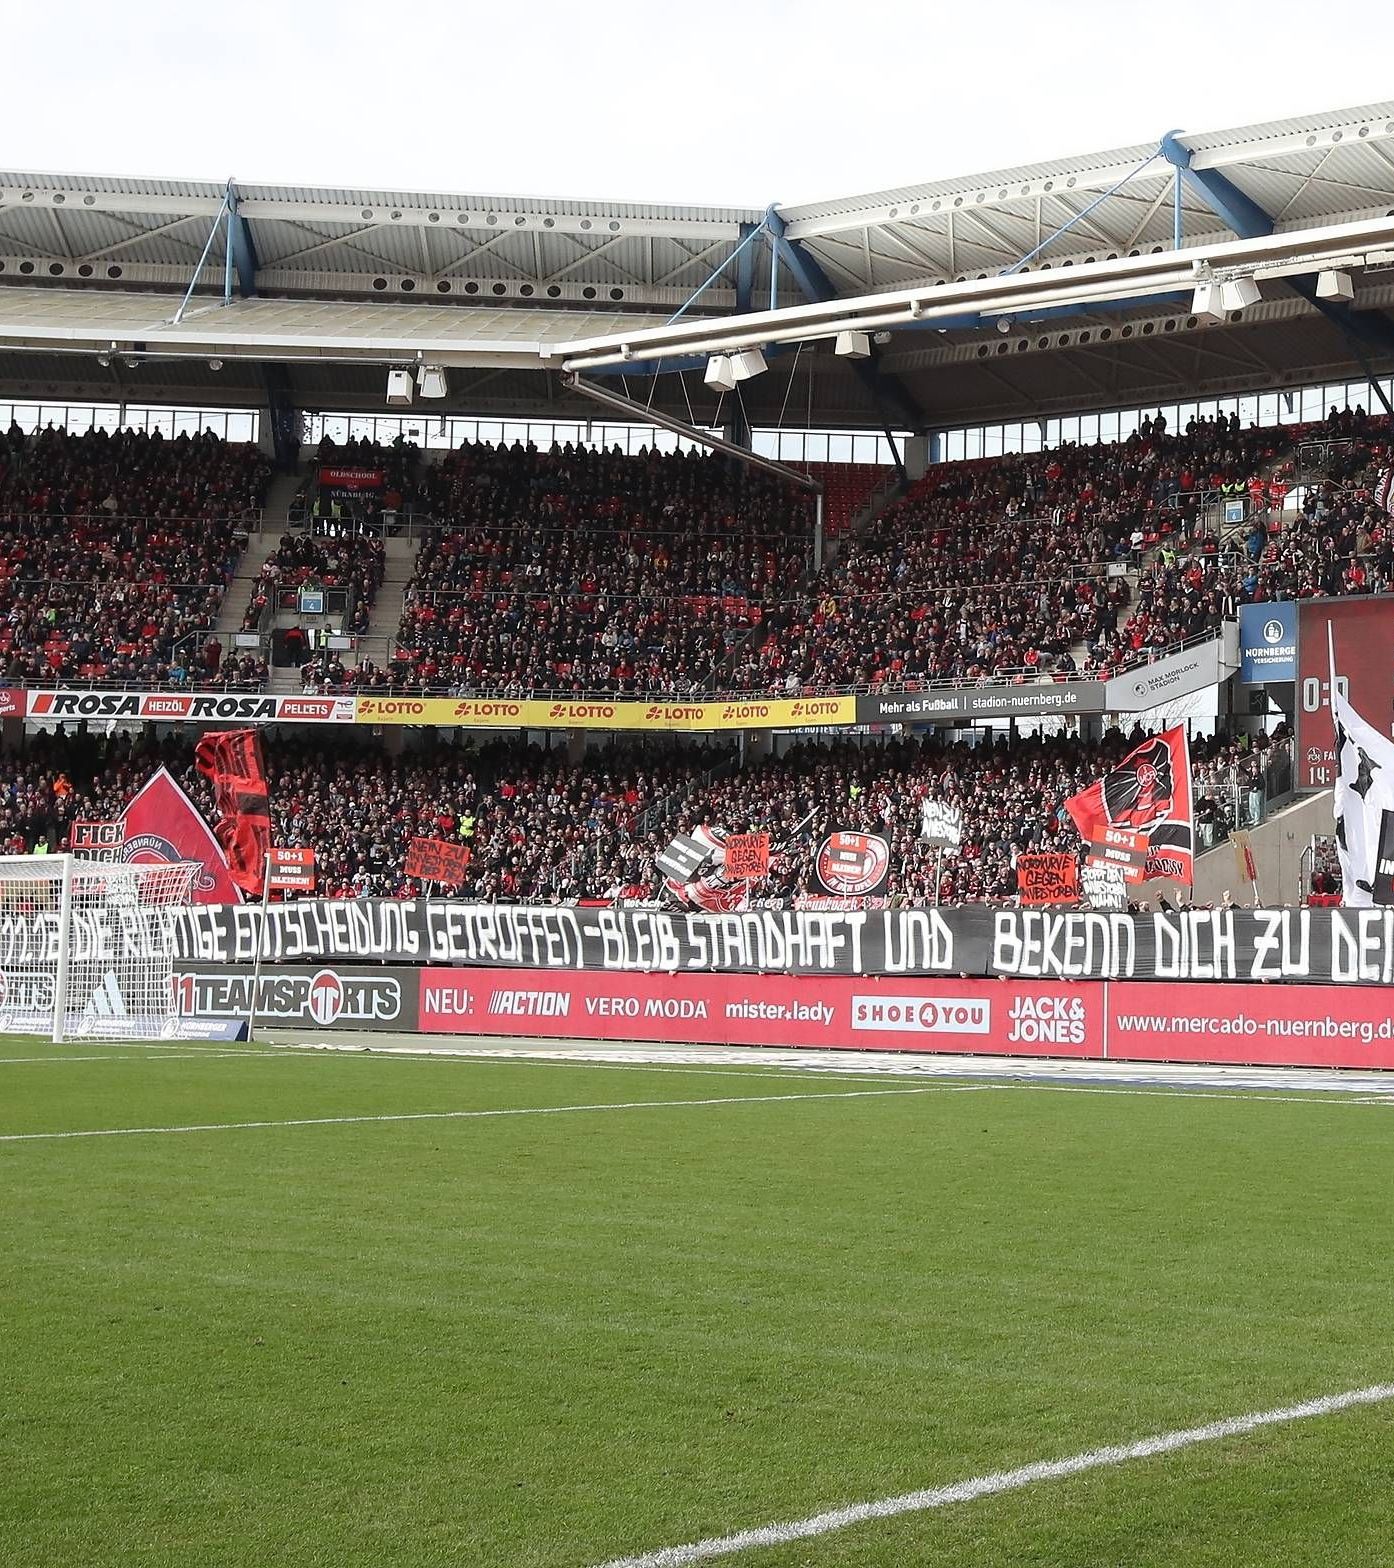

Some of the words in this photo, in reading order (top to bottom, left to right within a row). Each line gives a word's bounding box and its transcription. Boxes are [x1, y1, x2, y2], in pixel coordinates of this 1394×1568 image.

[330, 471, 377, 479] OLDSCHOOL
[1253, 656, 1294, 664] VERSICHERUNG
[1148, 674, 1164, 685] MAX
[1165, 662, 1200, 679] MORLOCK
[1150, 675, 1180, 692] STADION
[53, 695, 140, 716] ROSA
[148, 699, 185, 712] HEIZÖL
[191, 697, 277, 717] ROSA
[284, 703, 328, 715] PELLETS
[378, 702, 424, 714] LOTTO
[474, 703, 520, 717] LOTTO
[805, 702, 839, 715] LOTTO
[880, 702, 904, 714] Mehr
[906, 701, 920, 712] als
[922, 698, 958, 712] Fußball
[972, 692, 1077, 709] stadion-nuernberg.de
[568, 705, 614, 718] LOTTO
[664, 706, 704, 720] LOTTO
[736, 706, 769, 718] LOTTO
[75, 823, 125, 845] FICK
[1105, 830, 1136, 848] 50+1
[277, 850, 304, 862] 50+1
[732, 849, 762, 863] GEGEN
[1104, 848, 1132, 863] MUSS
[280, 865, 302, 874] MUSS
[1018, 855, 1074, 873] NORDKURVE
[1026, 870, 1067, 886] GEGEN
[233, 901, 419, 959] ENTSCHEIDUNG
[426, 902, 583, 969] GETROFFEN
[686, 909, 867, 973] STANDHAFT
[884, 908, 954, 971] UND
[993, 911, 1136, 977] BEKENN
[1155, 909, 1237, 979] DICH
[1250, 909, 1311, 978] ZU
[424, 988, 474, 1015] NEU:
[586, 997, 640, 1017] VERO
[644, 998, 708, 1018] MODA
[1008, 996, 1086, 1021] JACK&
[1008, 1018, 1086, 1044] JONES
